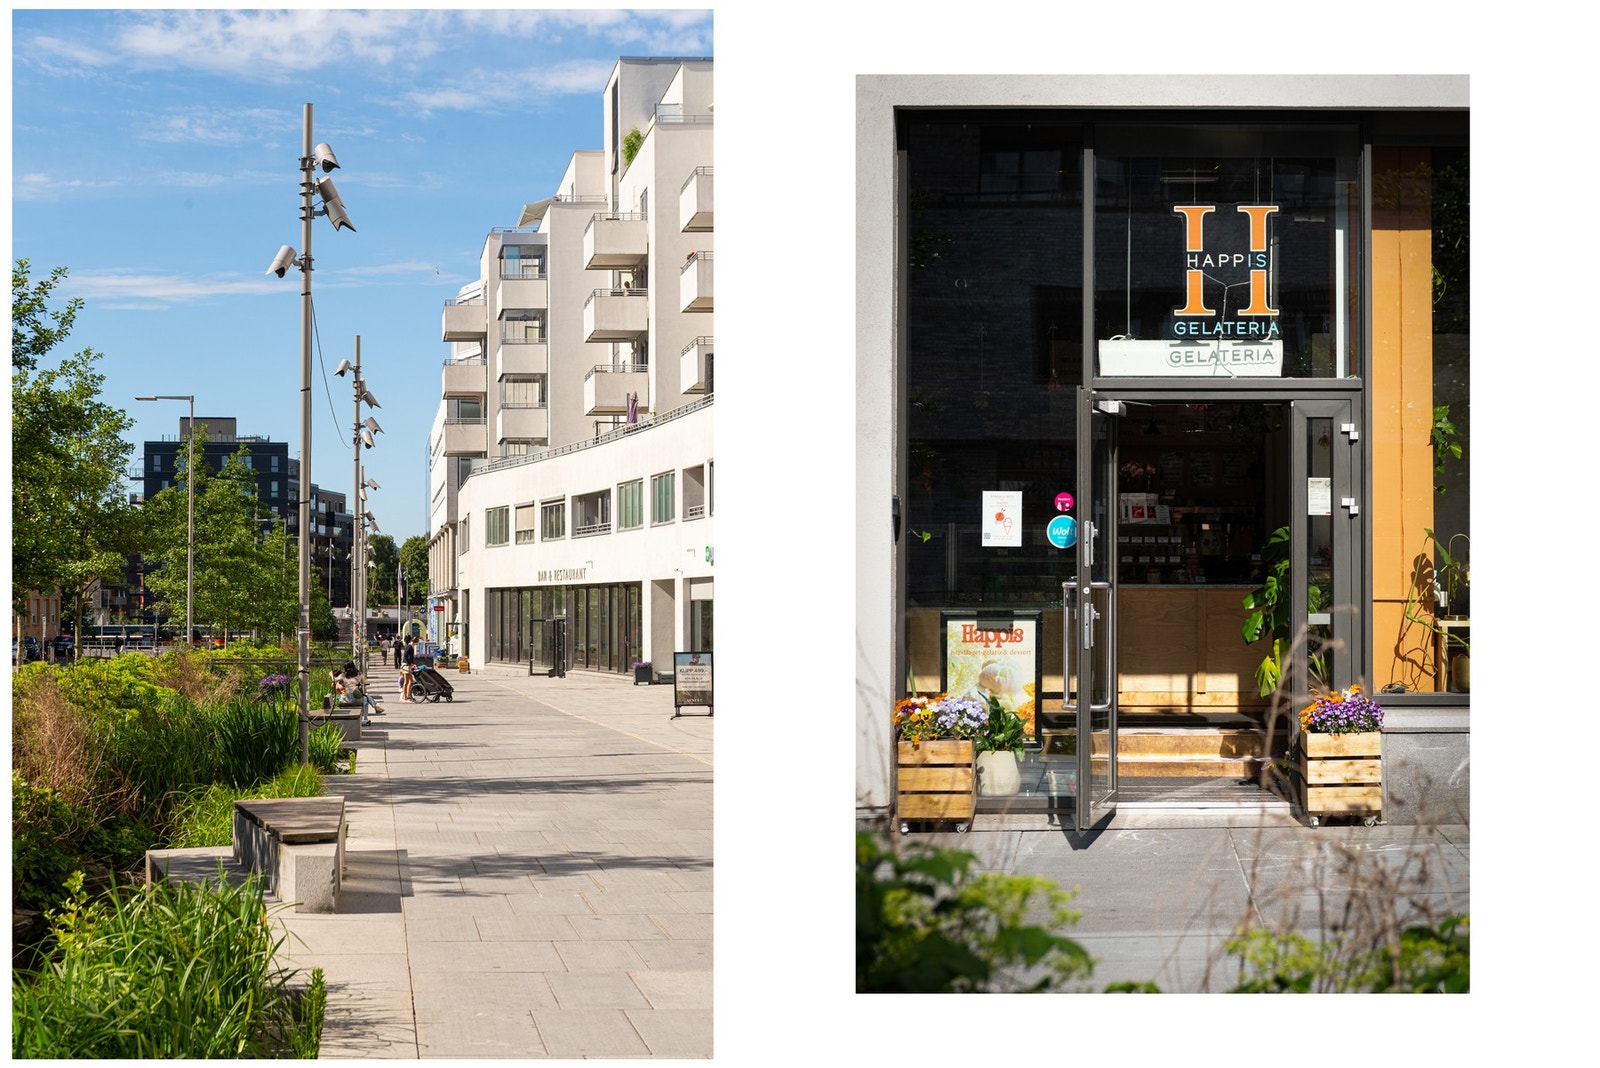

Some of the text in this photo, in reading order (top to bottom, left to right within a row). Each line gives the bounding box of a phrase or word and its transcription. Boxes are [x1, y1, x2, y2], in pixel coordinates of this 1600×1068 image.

[1187, 254, 1267, 268] HAPPIS
[1174, 322, 1279, 335] GELATERIA
[1169, 349, 1274, 364] GELATERIA
[1052, 527, 1074, 536] Wolt
[554, 568, 586, 581] RESTAURANT
[961, 623, 1024, 648] Happis
